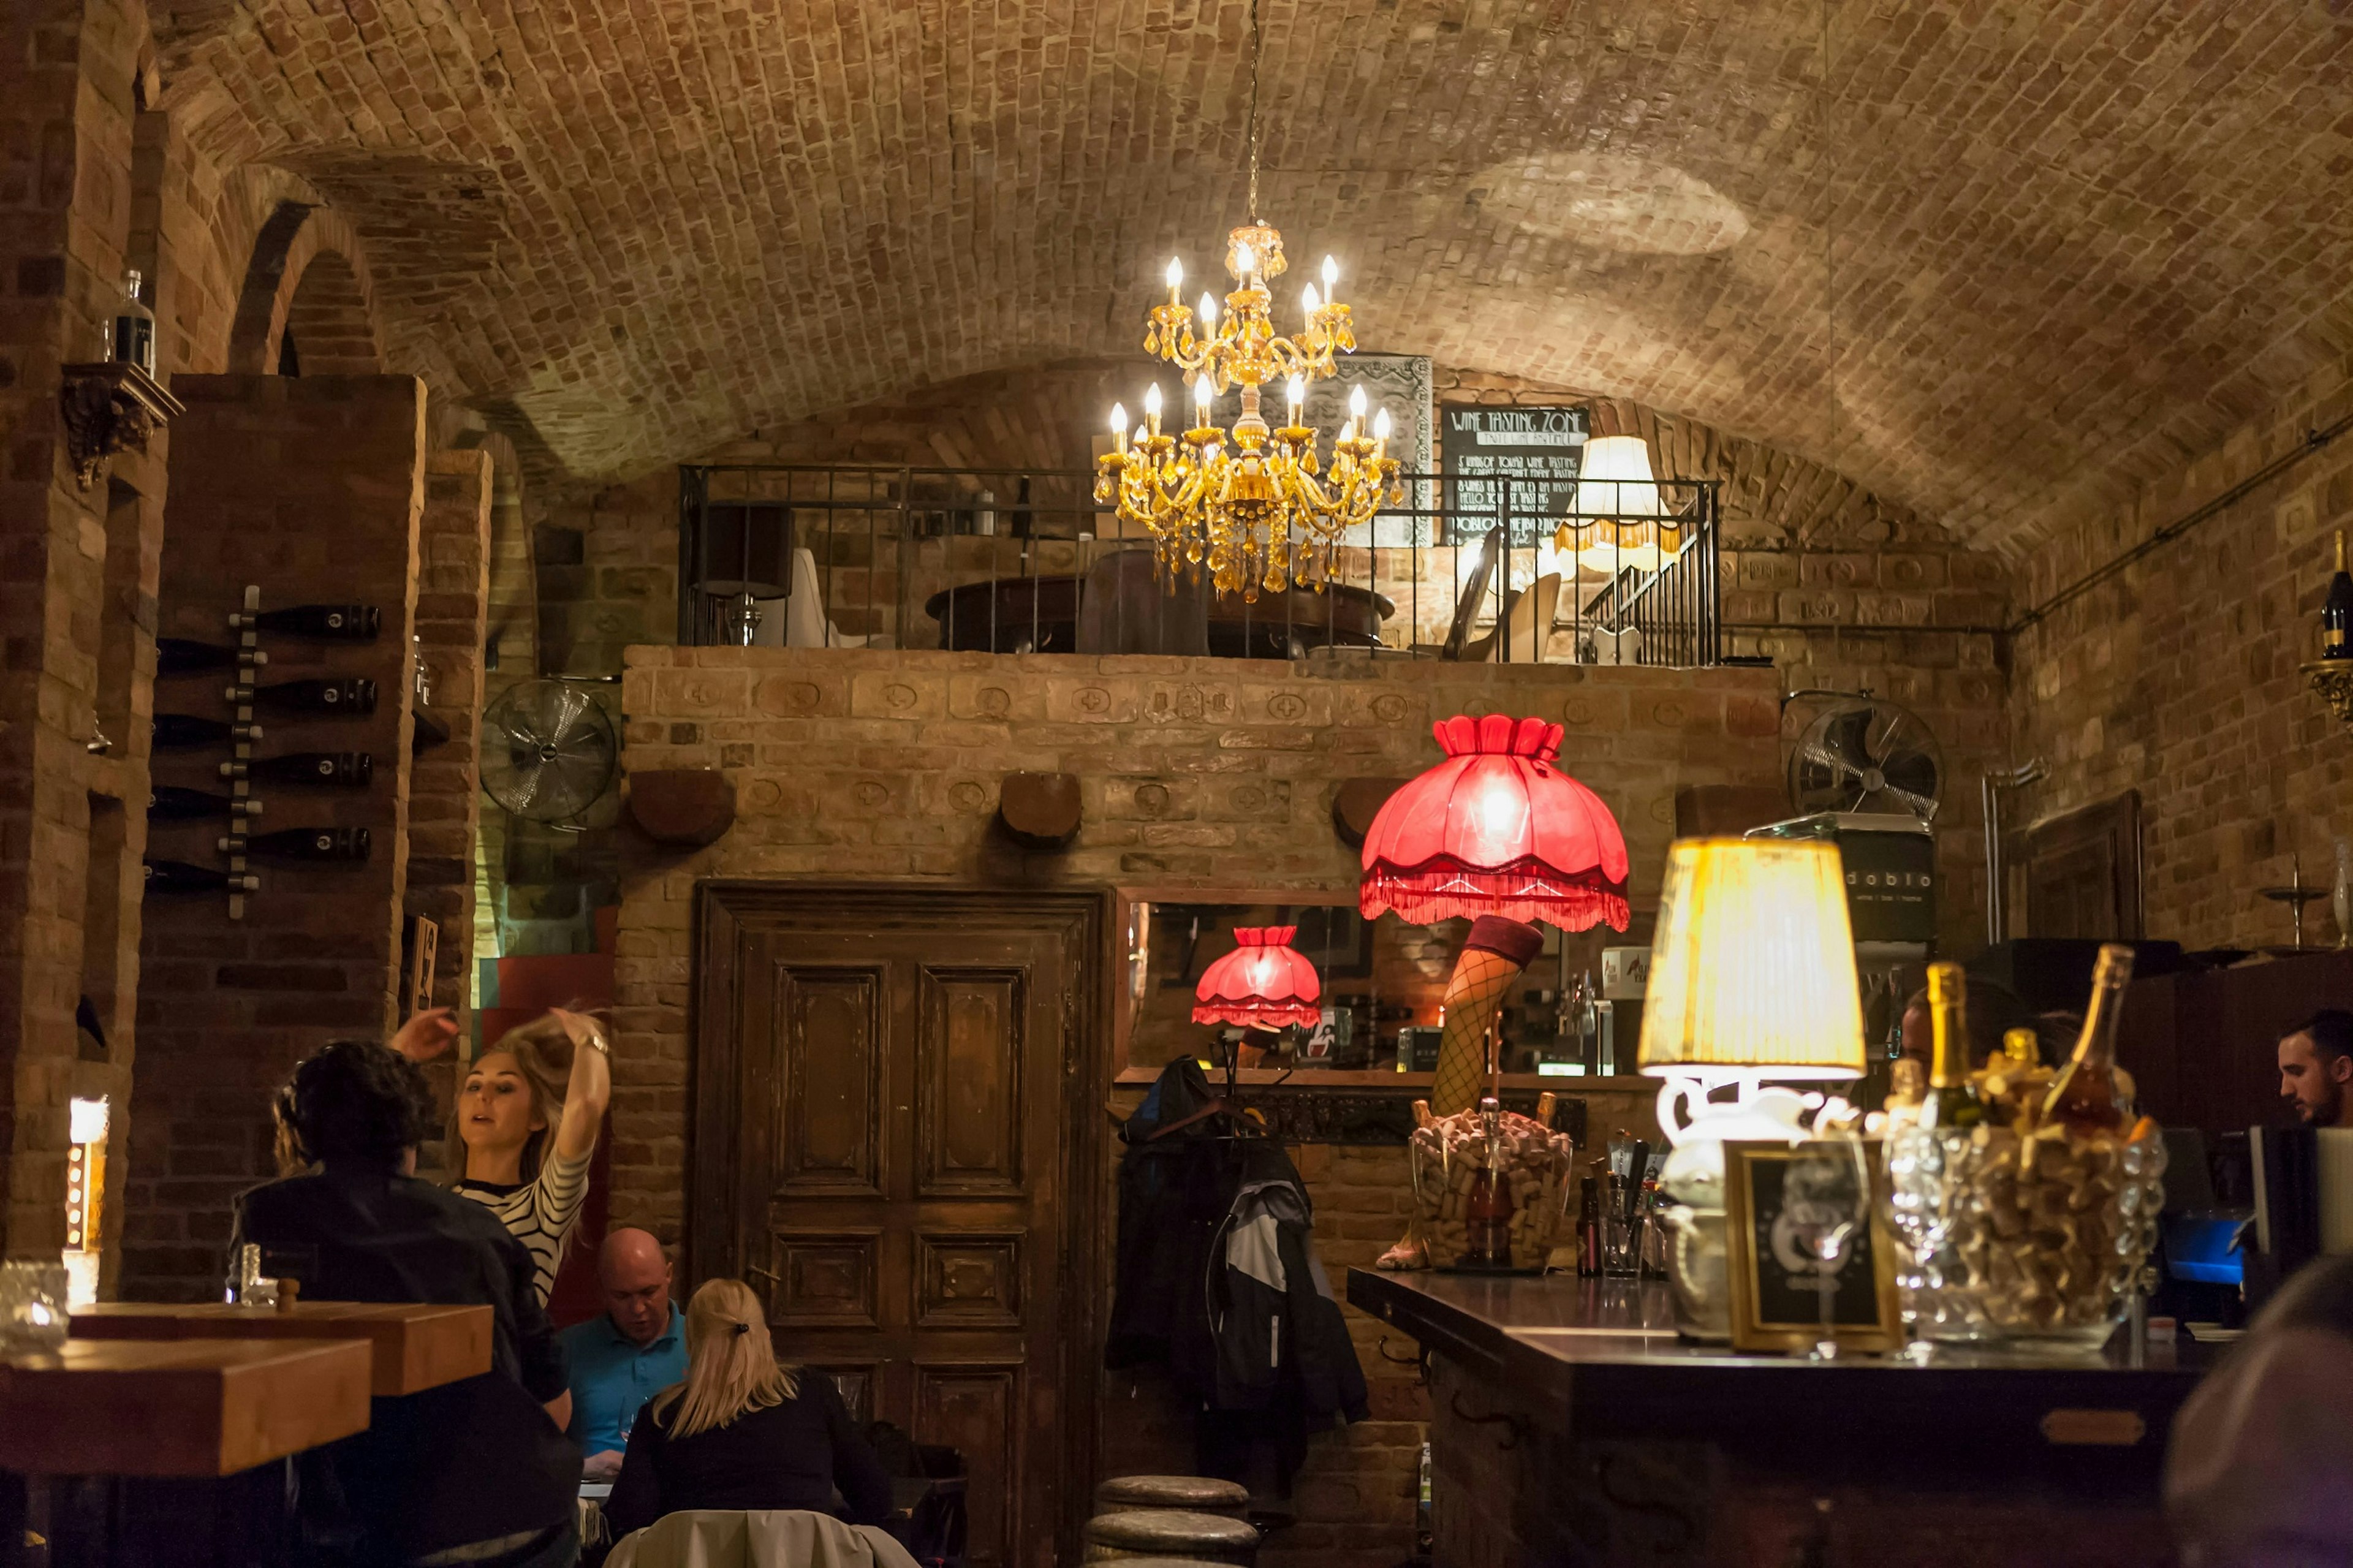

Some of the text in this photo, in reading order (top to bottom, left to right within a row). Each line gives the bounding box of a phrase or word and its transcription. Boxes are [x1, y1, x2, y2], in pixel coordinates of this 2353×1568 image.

[1451, 411, 1582, 433] WINE TASTING ZONE
[1526, 456, 1544, 468] WINE
[1548, 456, 1577, 469] TASTING
[1552, 482, 1577, 493] TASTIN
[1459, 492, 1484, 504] HELLO
[1847, 871, 1931, 887] doblo
